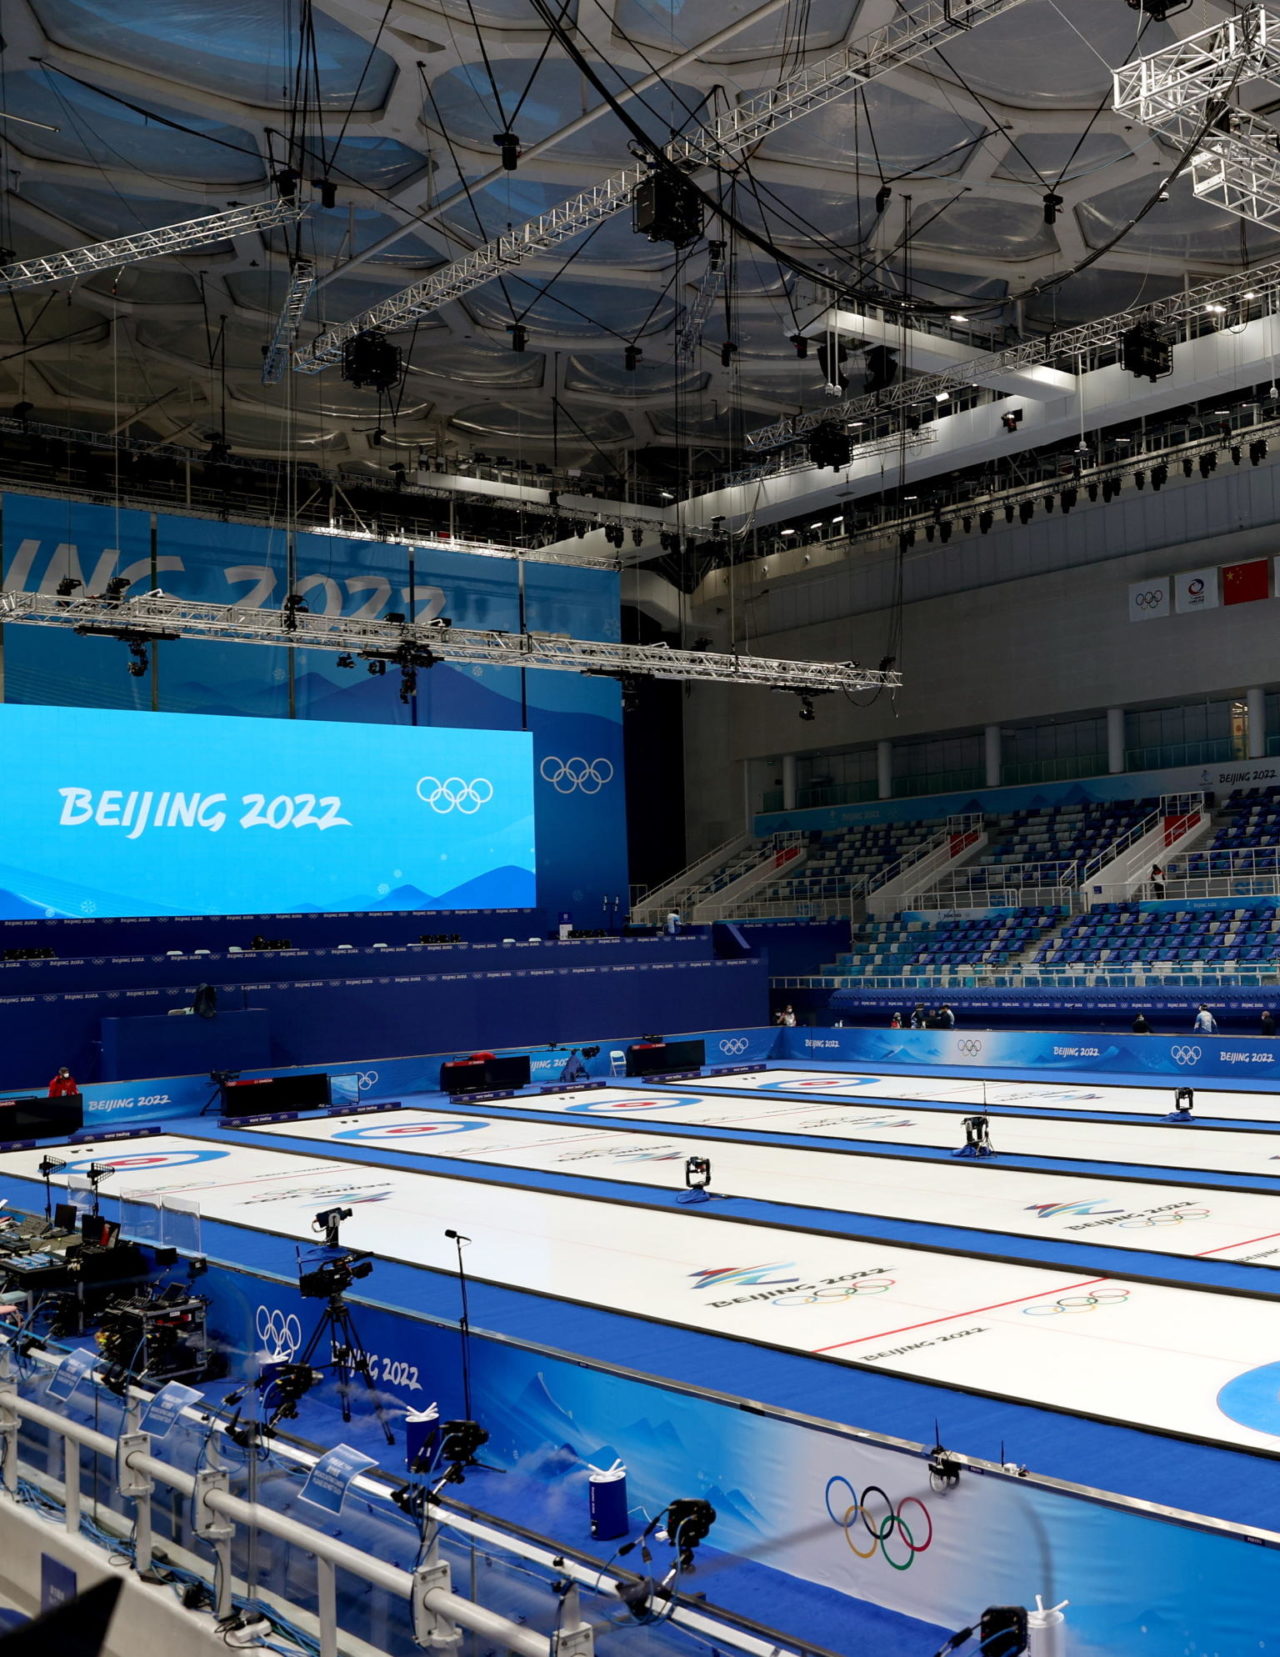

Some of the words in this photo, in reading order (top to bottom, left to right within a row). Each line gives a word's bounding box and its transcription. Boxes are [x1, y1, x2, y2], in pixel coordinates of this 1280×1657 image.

[223, 565, 448, 628] 2022
[1219, 772, 1251, 785] BEIJING
[1252, 770, 1278, 781] 2022
[58, 787, 227, 840] BEIJING
[240, 793, 353, 830] 2022
[805, 1039, 825, 1048] BEIJING
[825, 1040, 839, 1048] 2022
[1054, 1047, 1078, 1058] BEIJING
[1080, 1048, 1100, 1056] 2022
[1221, 1052, 1249, 1064] BEIJING
[1252, 1053, 1276, 1062] 2022
[88, 1098, 134, 1112] BEIJING
[137, 1095, 172, 1106] 2022
[1064, 1213, 1146, 1231] BEIJING
[1143, 1201, 1202, 1214] 2022
[704, 1284, 817, 1308] BEIJING
[820, 1267, 899, 1285] 2022
[858, 1340, 936, 1361] BEIJING
[936, 1327, 991, 1342] 2022
[383, 1358, 424, 1391] 2022
